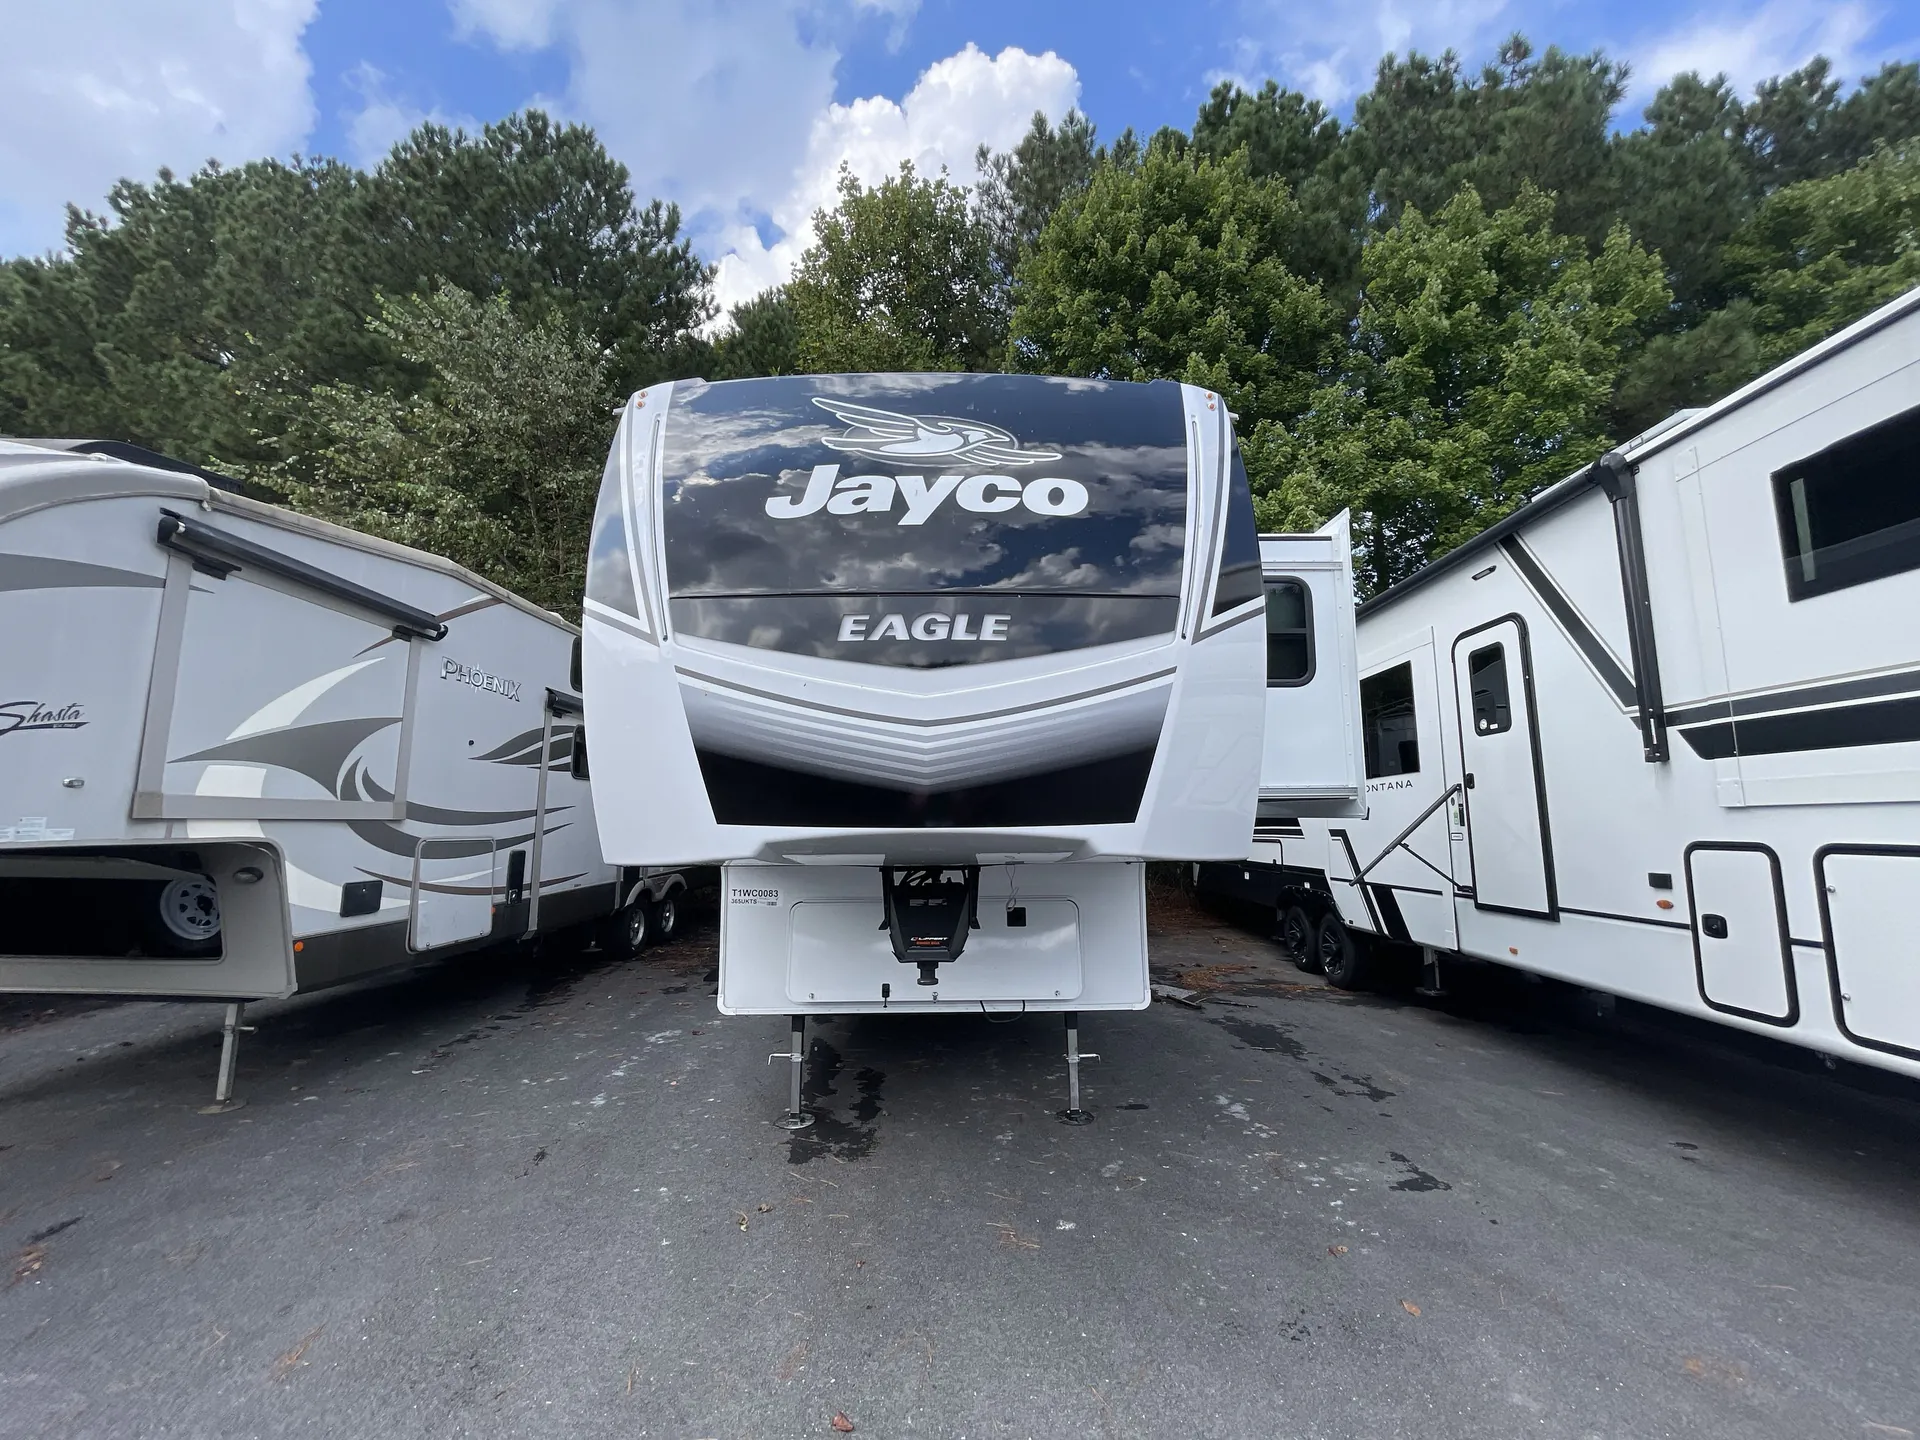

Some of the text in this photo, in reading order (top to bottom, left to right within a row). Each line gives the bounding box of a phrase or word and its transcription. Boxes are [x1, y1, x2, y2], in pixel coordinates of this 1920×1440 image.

[765, 463, 1089, 526] Jayco
[836, 613, 1012, 642] EAGLE
[440, 655, 521, 702] PHOENIX
[731, 888, 779, 898] T1WC0083
